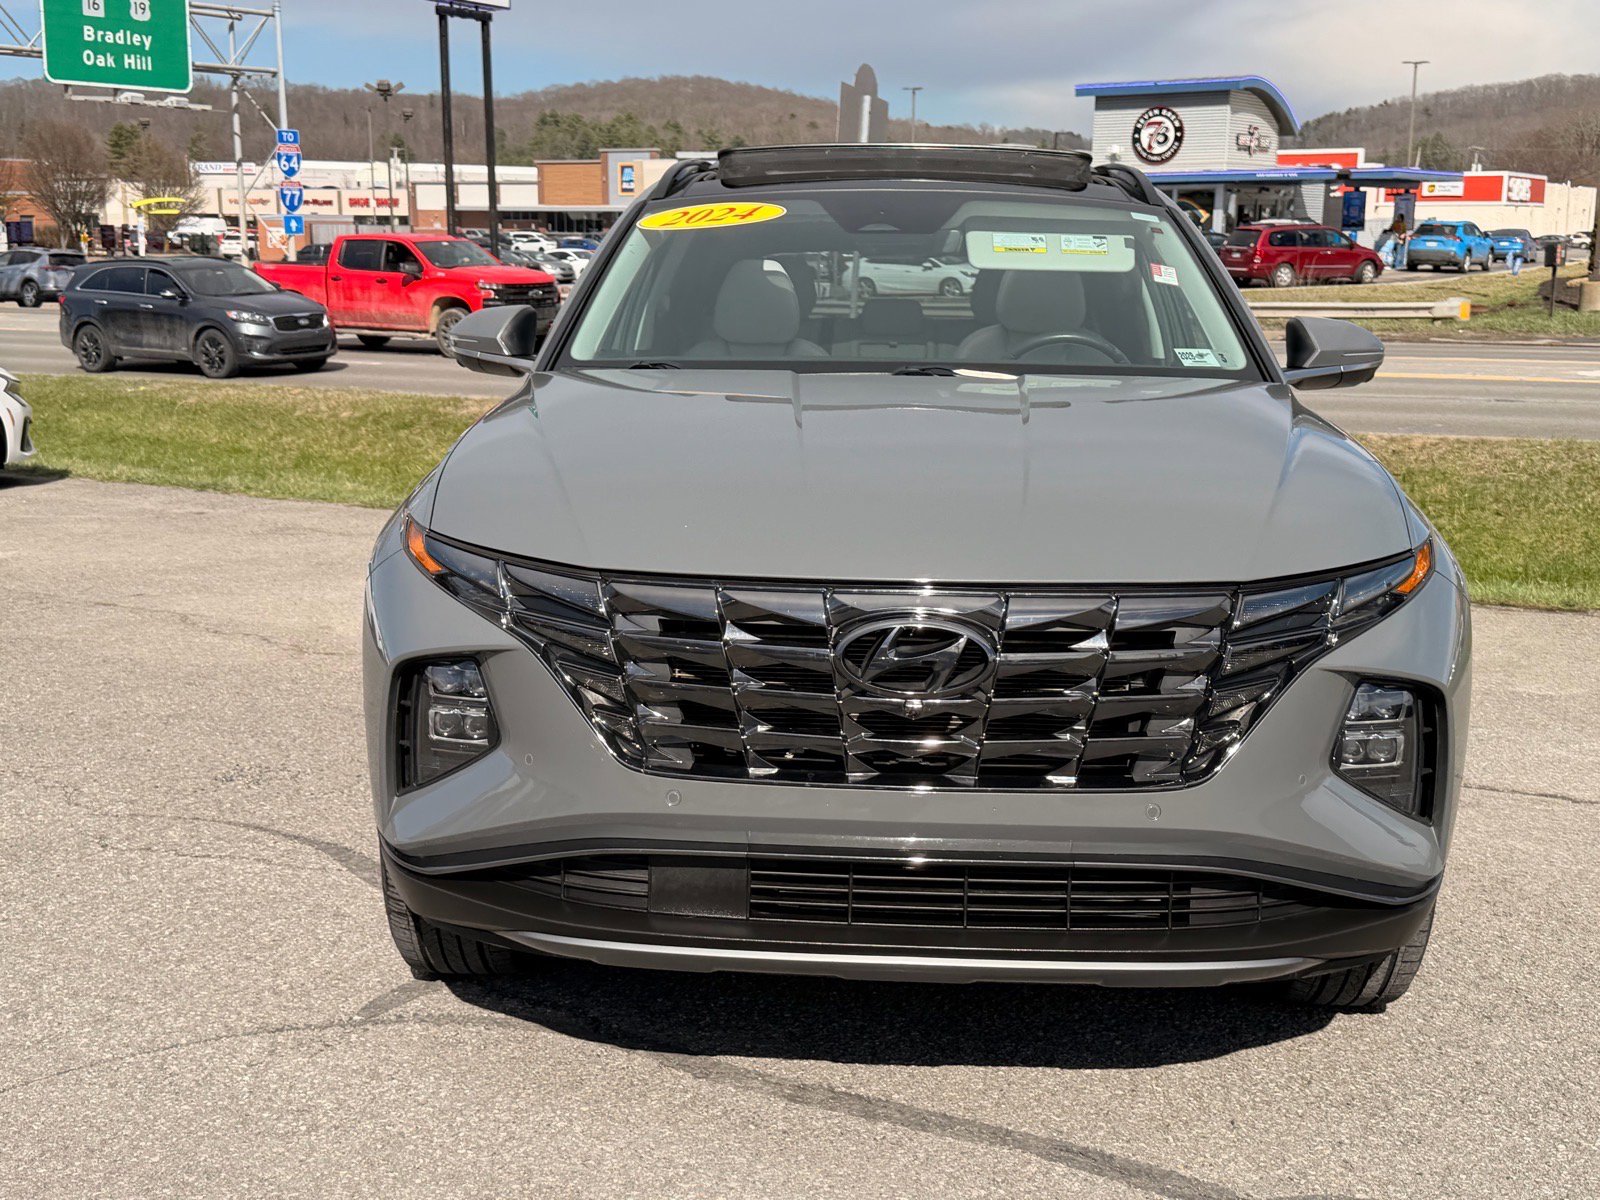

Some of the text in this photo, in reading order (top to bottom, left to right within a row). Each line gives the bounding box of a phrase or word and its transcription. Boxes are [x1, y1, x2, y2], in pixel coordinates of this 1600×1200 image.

[86, 0, 101, 11] 16
[133, 2, 147, 15] 19
[83, 25, 152, 51] Bradley
[82, 49, 152, 71] Oak Hill
[281, 131, 295, 142] TO
[280, 155, 299, 171] 64
[283, 189, 301, 206] 77
[660, 204, 764, 227] 2024
